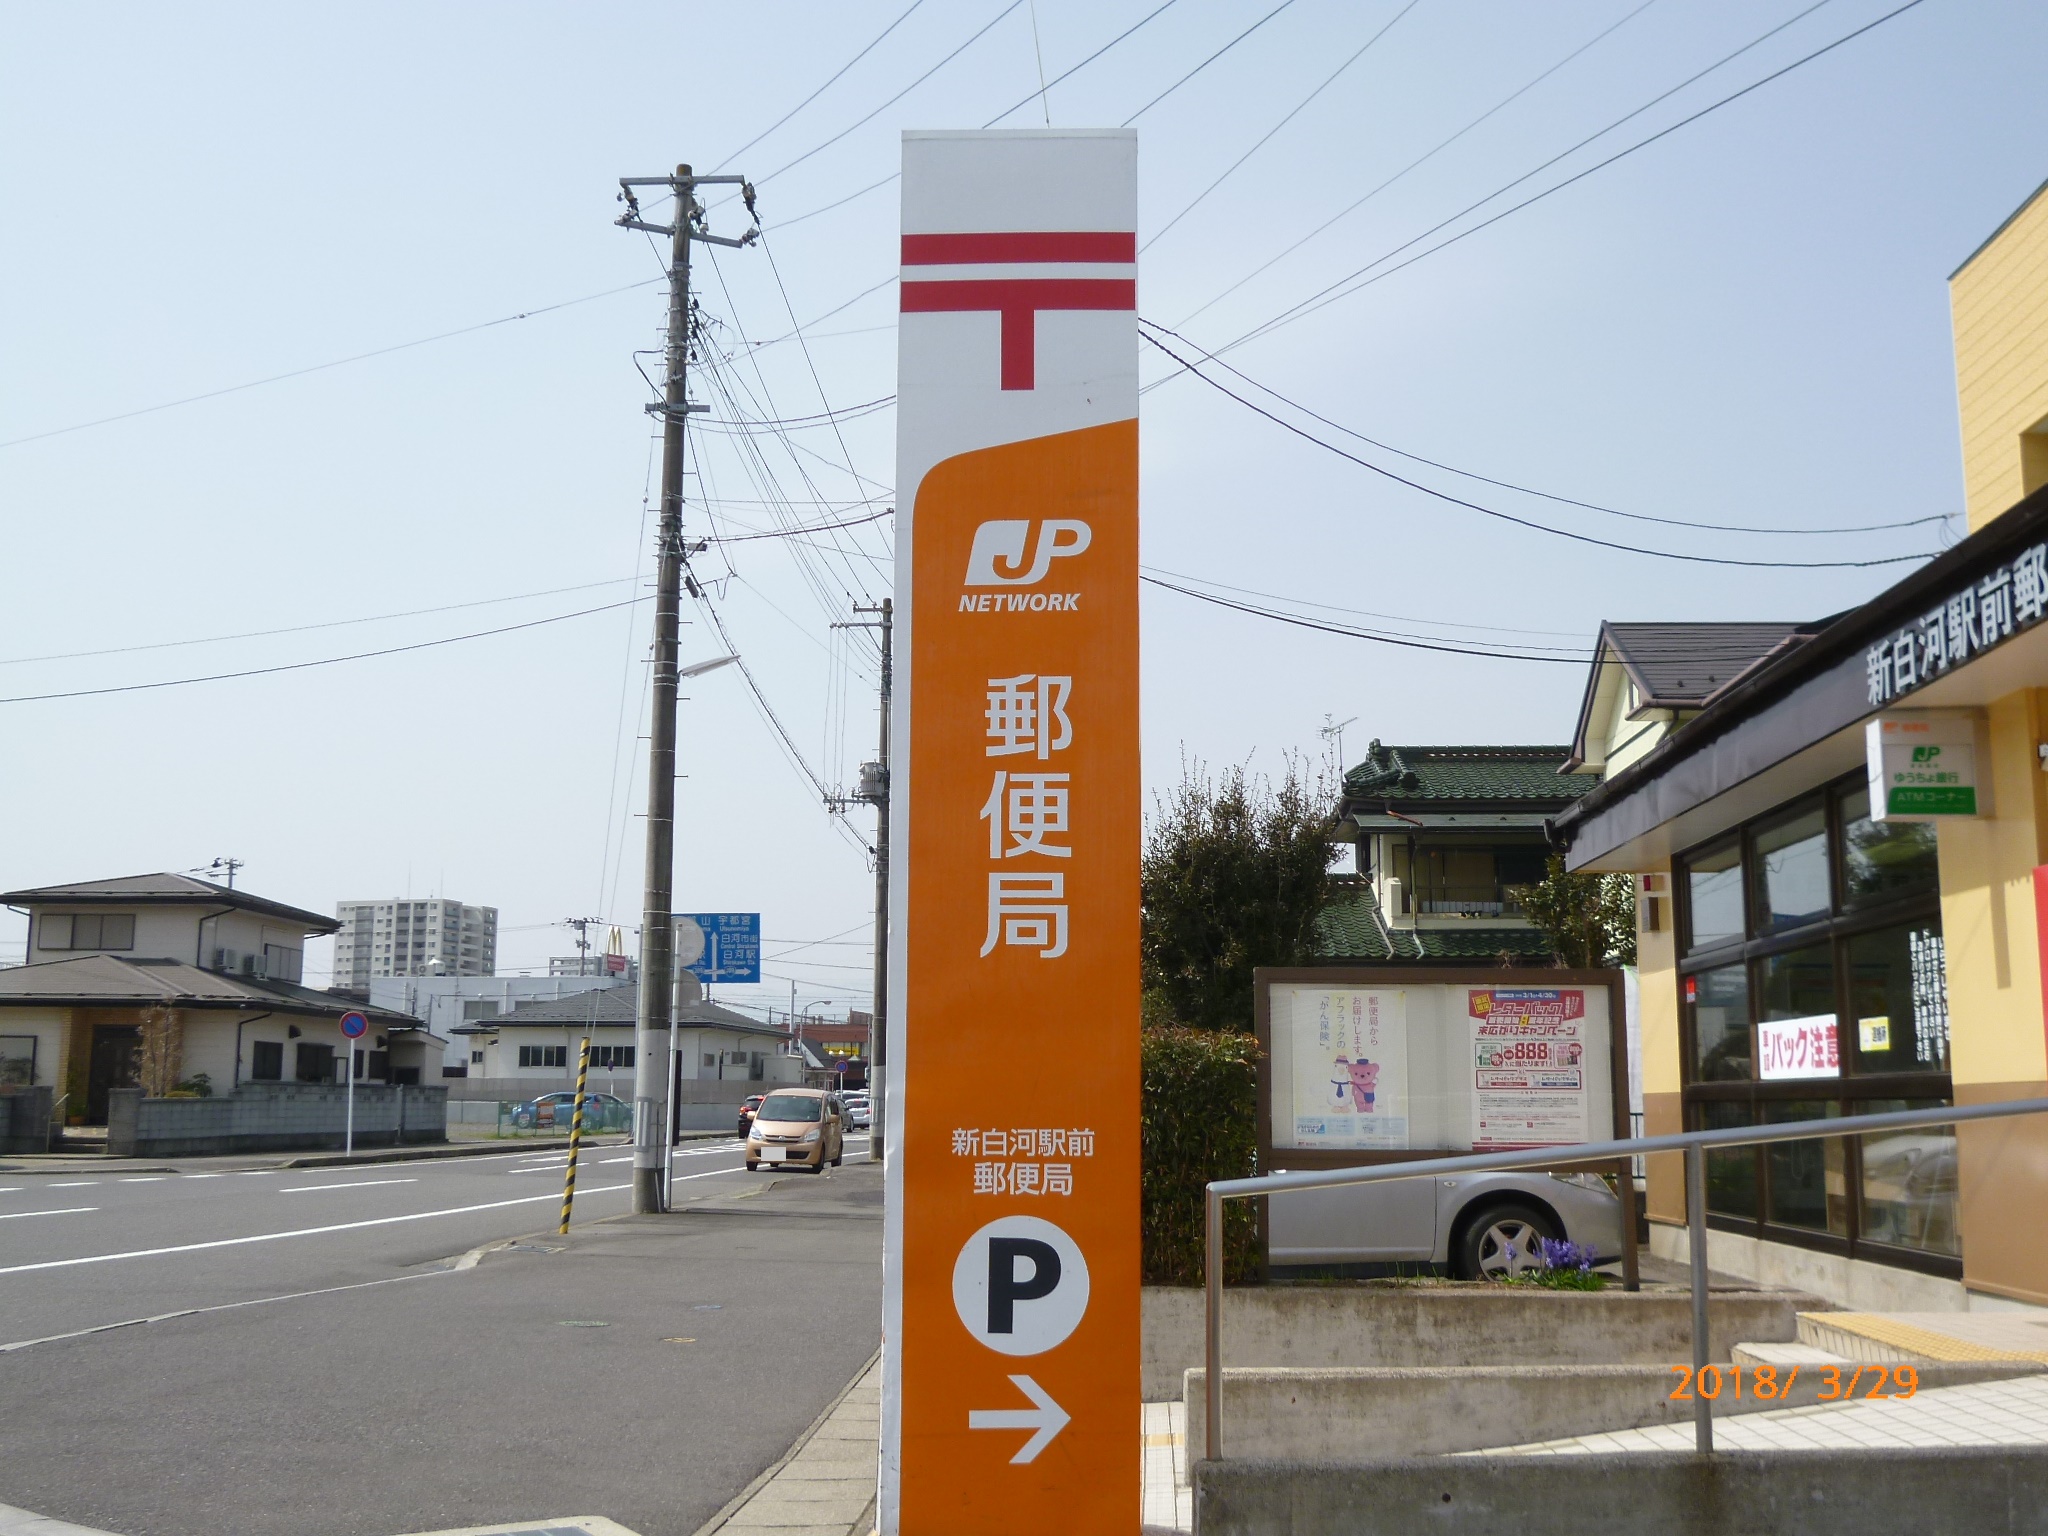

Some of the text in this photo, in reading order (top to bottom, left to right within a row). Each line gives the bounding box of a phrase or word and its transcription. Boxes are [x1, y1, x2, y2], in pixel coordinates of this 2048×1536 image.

[964, 519, 1092, 586] JP
[958, 593, 1081, 612] NETWORK
[1893, 771, 1959, 783] ゆうちょ銀行
[980, 674, 1073, 959] 郵便局
[1368, 996, 1379, 1046] 郵便局から
[1515, 1042, 1548, 1060] 888
[952, 1127, 1096, 1157] 新白河駅前
[973, 1161, 1074, 1196] 郵便局
[987, 1236, 1062, 1334] P
